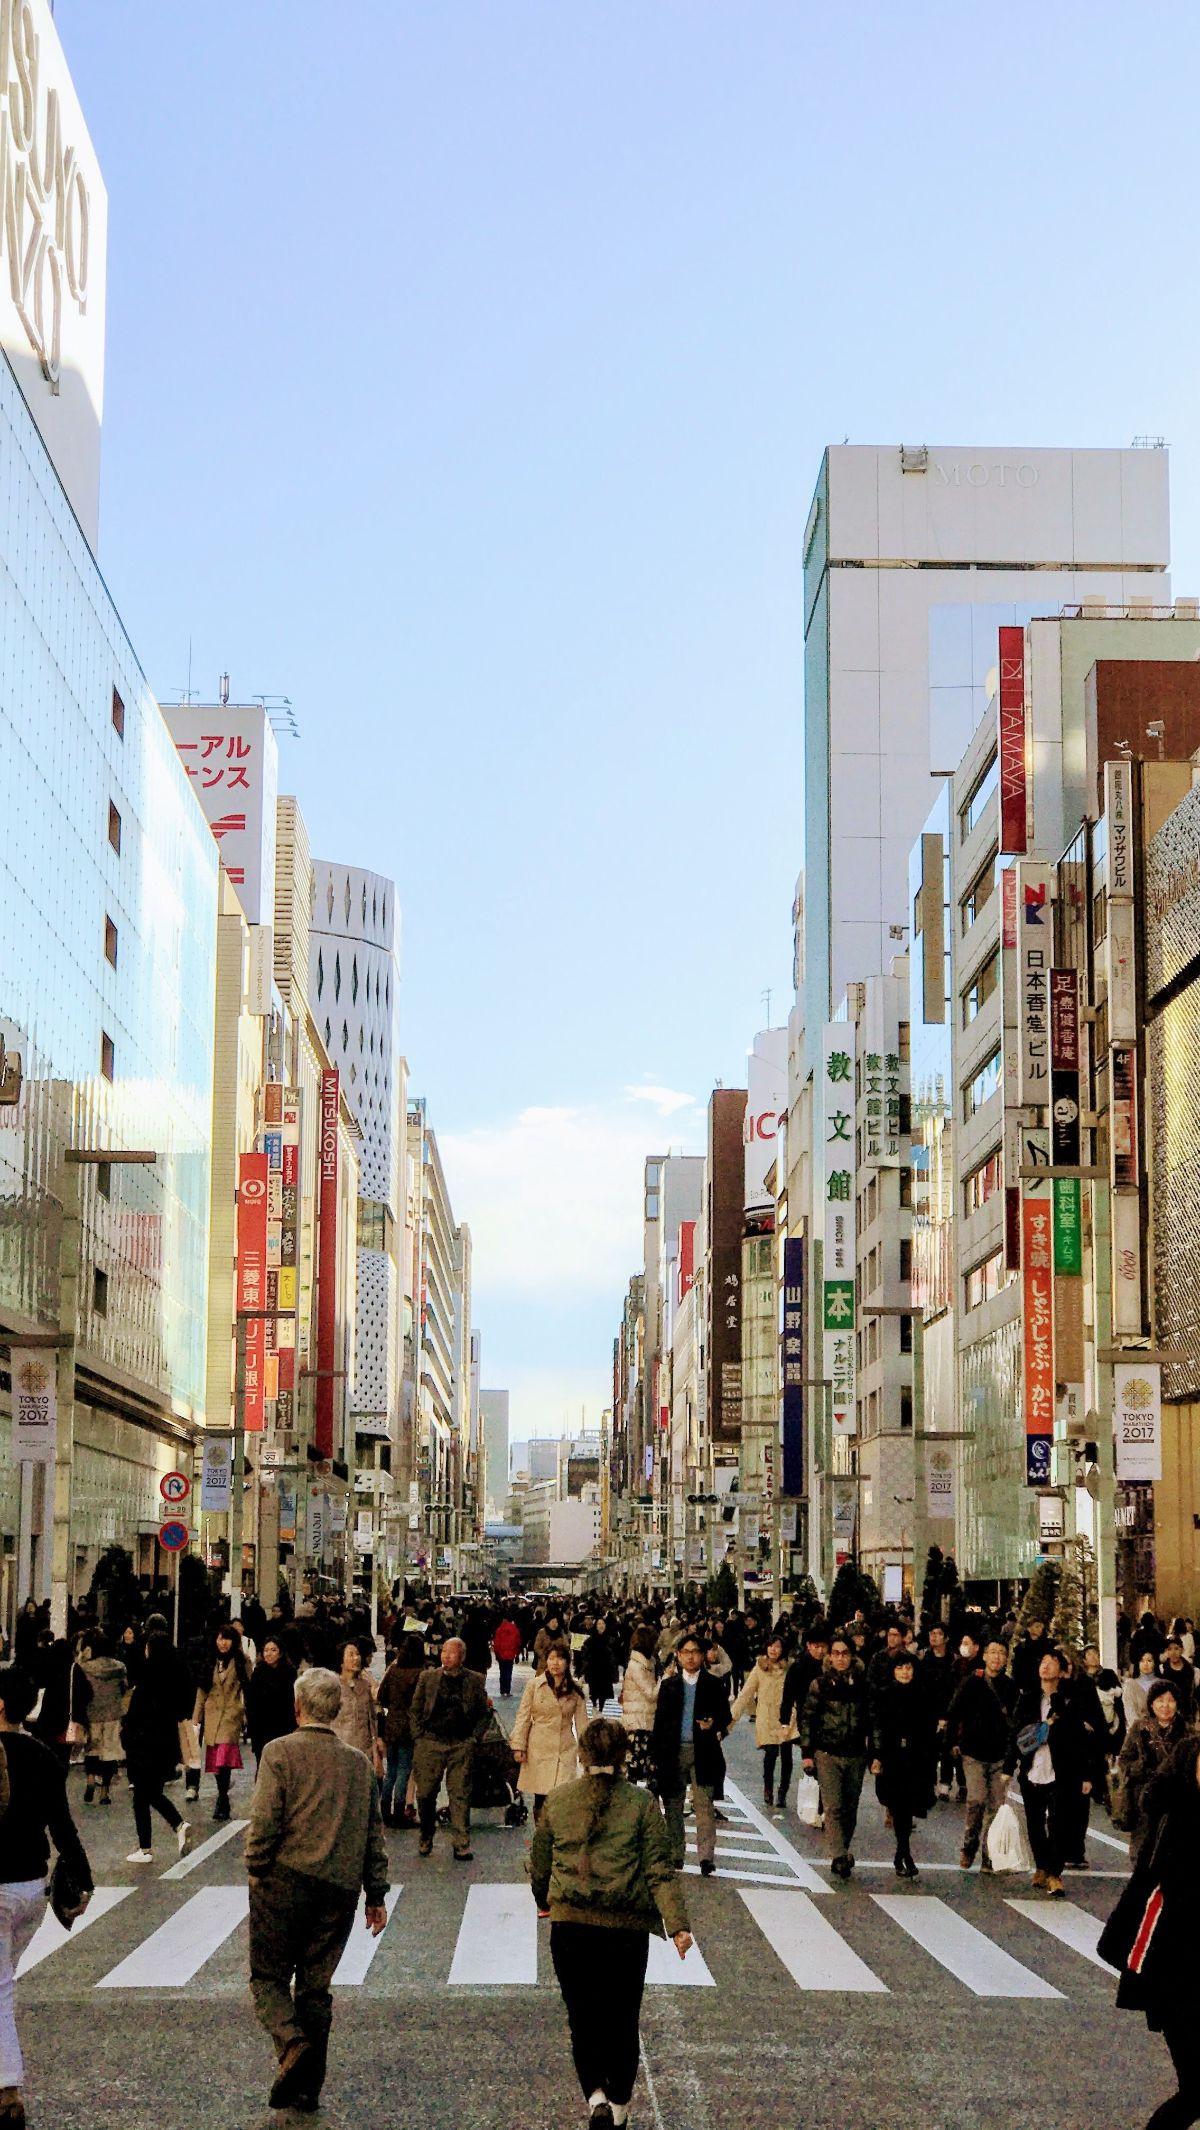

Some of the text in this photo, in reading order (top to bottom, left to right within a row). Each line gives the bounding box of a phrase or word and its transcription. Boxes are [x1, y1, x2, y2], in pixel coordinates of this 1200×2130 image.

[935, 464, 1040, 488] MOTO
[1001, 703, 1024, 800] TAMAYA
[1026, 950, 1047, 1080] 日本香堂ビル
[866, 1053, 882, 1157] 教文館ビル
[885, 1053, 900, 1157] 教文館ビル
[323, 1077, 337, 1181] MITSUKOSHI
[827, 1050, 852, 1201] 教文館
[835, 1215, 844, 1245] SINCE
[827, 1287, 852, 1322] 本
[786, 1286, 801, 1380] 山野楽器
[19, 1395, 49, 1404] TOKYO
[19, 1410, 49, 1421] 2017
[1122, 1413, 1155, 1421] TOKYO
[1122, 1427, 1155, 1438] 2017
[206, 1477, 227, 1485] 2017
[930, 1482, 952, 1491] 2017
